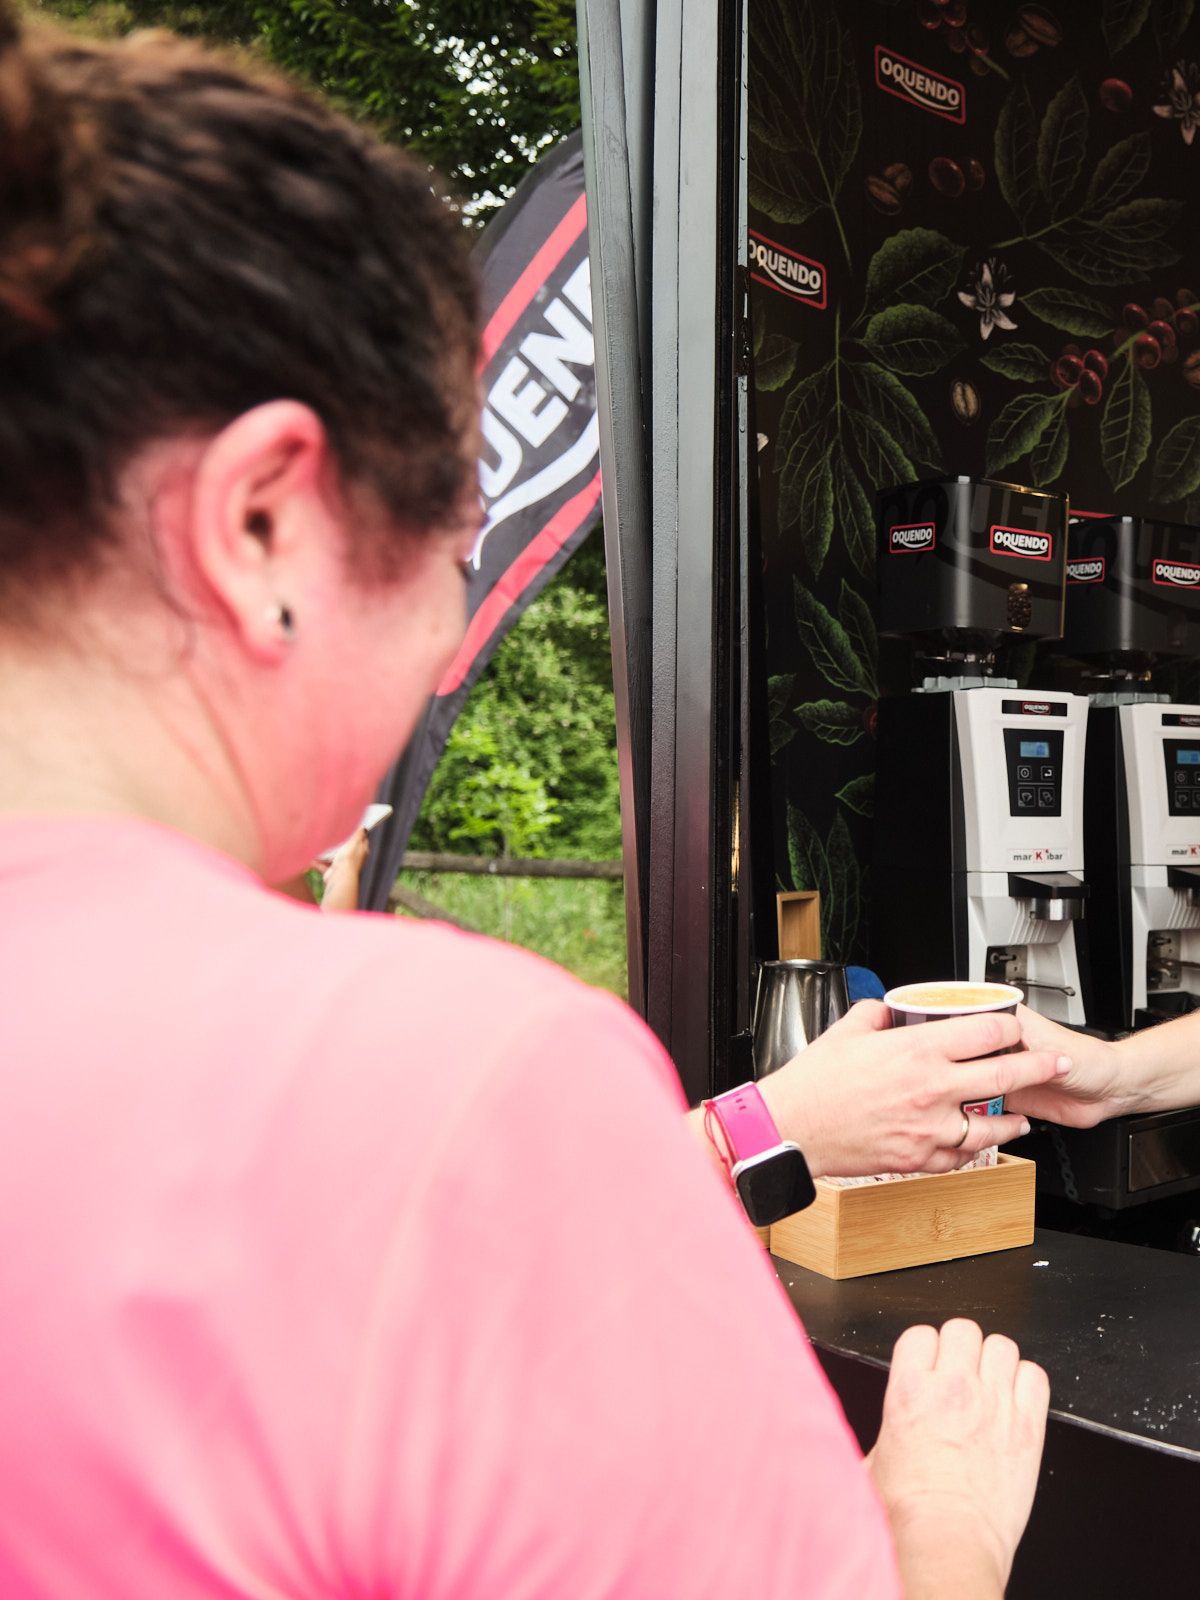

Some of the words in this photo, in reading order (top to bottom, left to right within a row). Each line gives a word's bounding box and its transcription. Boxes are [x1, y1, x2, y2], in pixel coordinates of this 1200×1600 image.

[880, 57, 960, 111] OQUENDO
[892, 527, 933, 549] OQUENDO
[993, 531, 1049, 556] OQUENDO
[1155, 564, 1200, 585] OQUENDO
